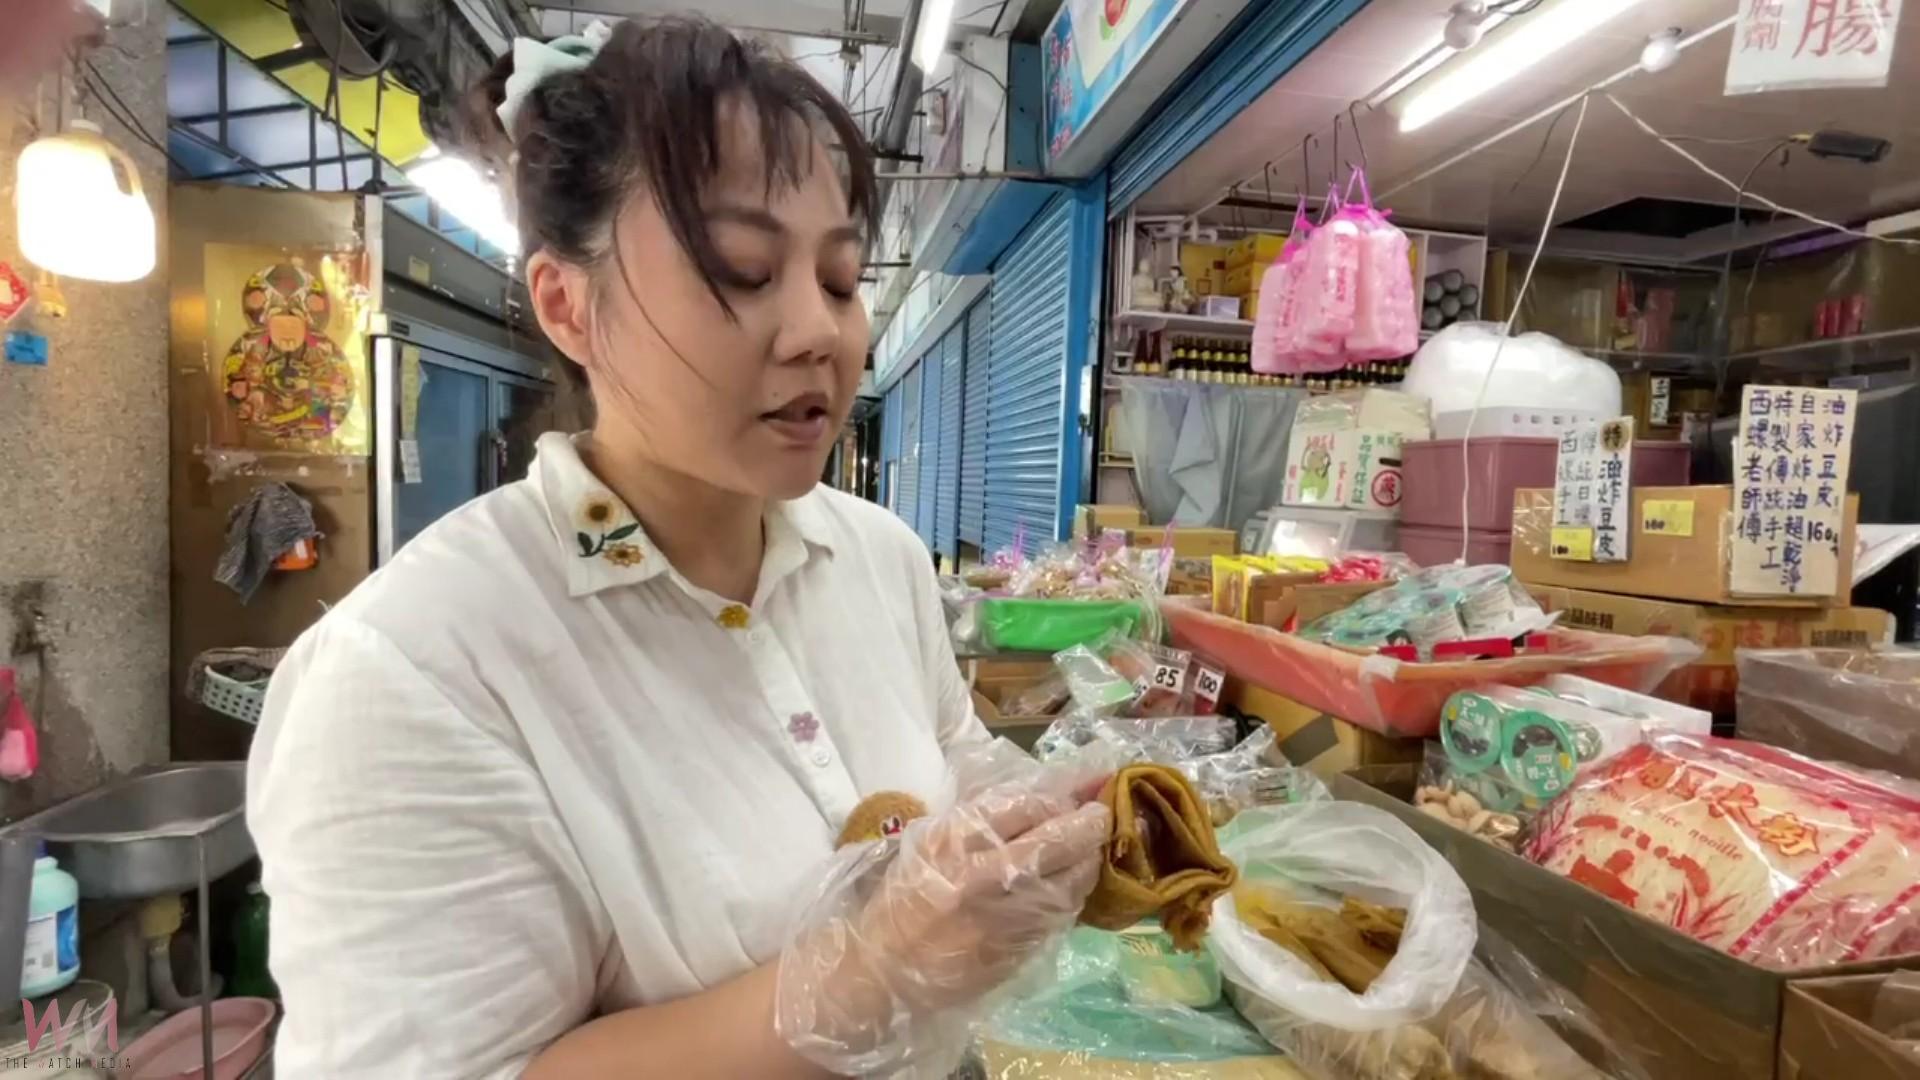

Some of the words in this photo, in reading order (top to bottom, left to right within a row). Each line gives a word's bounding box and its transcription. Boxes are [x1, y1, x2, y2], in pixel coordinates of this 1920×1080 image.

[1817, 395, 1847, 508] 油炸豆皮
[1597, 452, 1623, 557] 油炸豆皮
[1155, 667, 1179, 688] 85
[1199, 669, 1218, 694] 100
